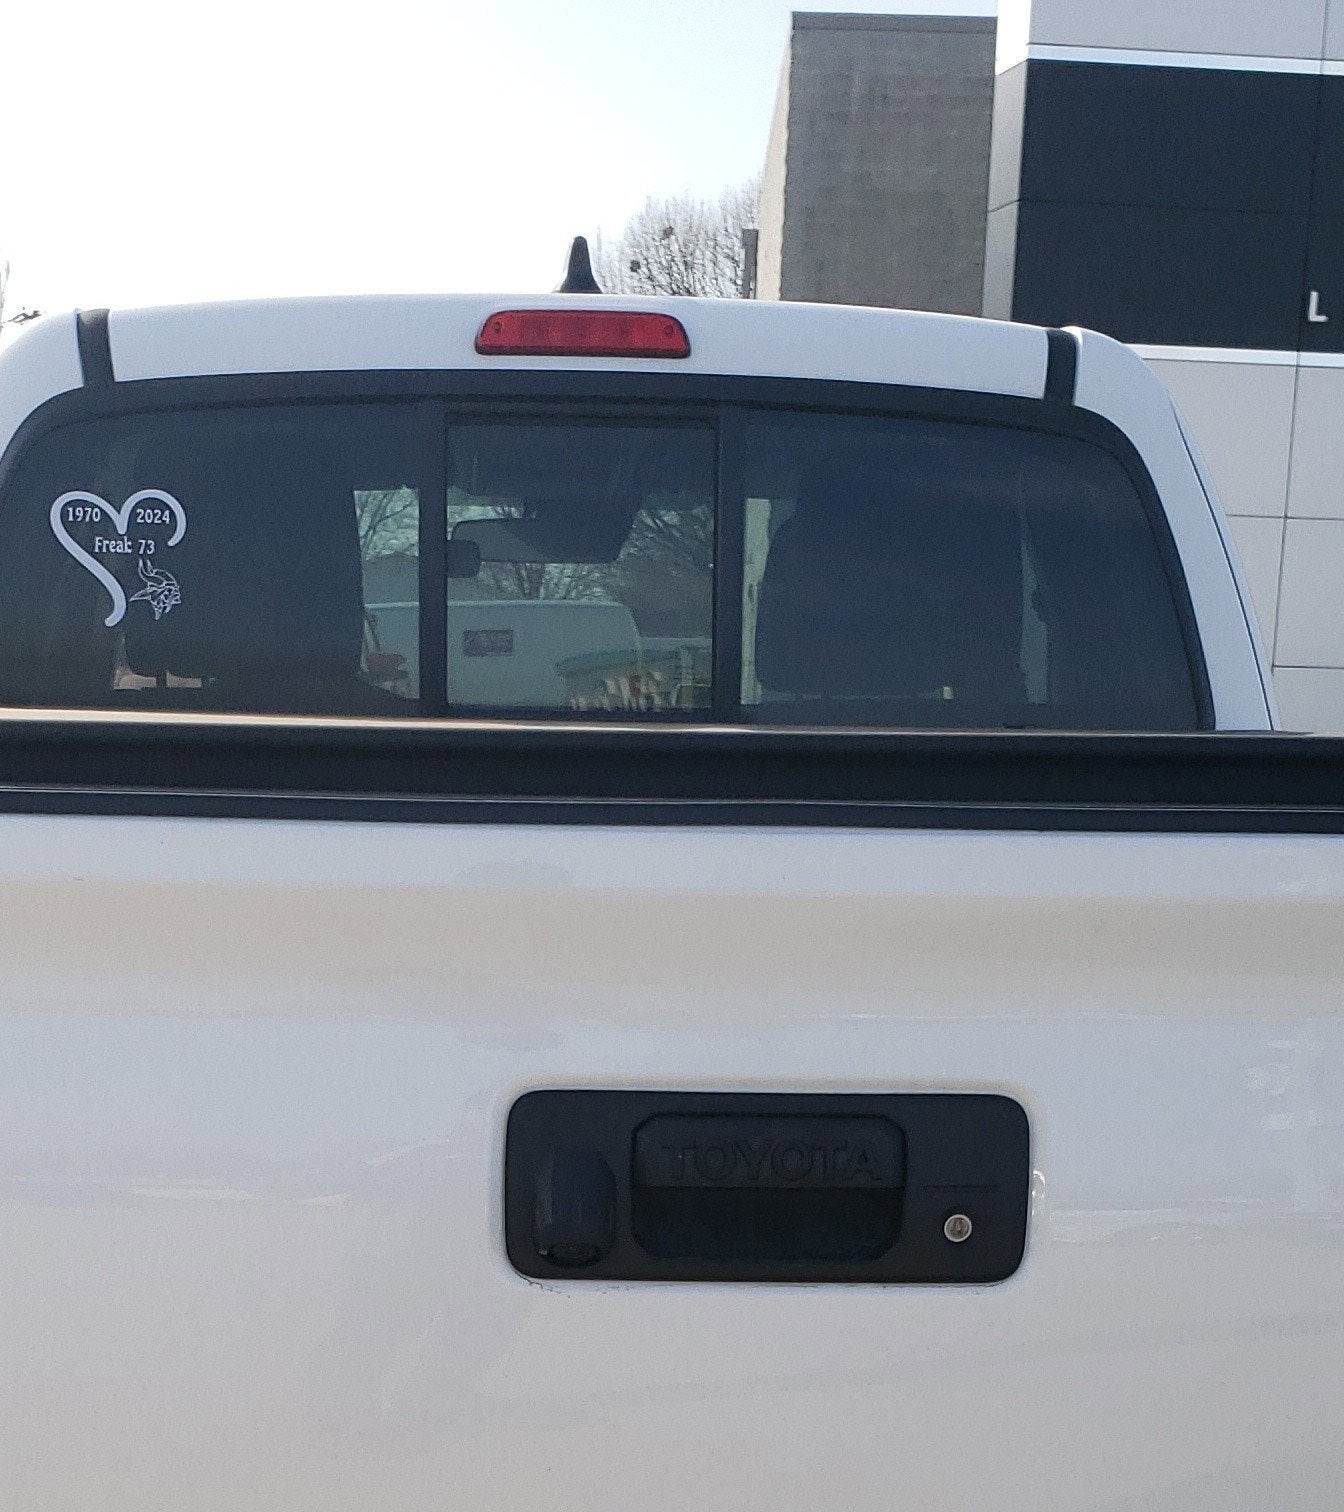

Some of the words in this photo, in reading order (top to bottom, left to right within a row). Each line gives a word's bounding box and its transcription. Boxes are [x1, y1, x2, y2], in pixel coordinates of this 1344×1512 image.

[66, 507, 101, 523] 1970
[136, 508, 171, 525] 2024
[94, 536, 133, 554] Freak
[138, 539, 156, 555] 73
[662, 1140, 884, 1182] TOYOTA
